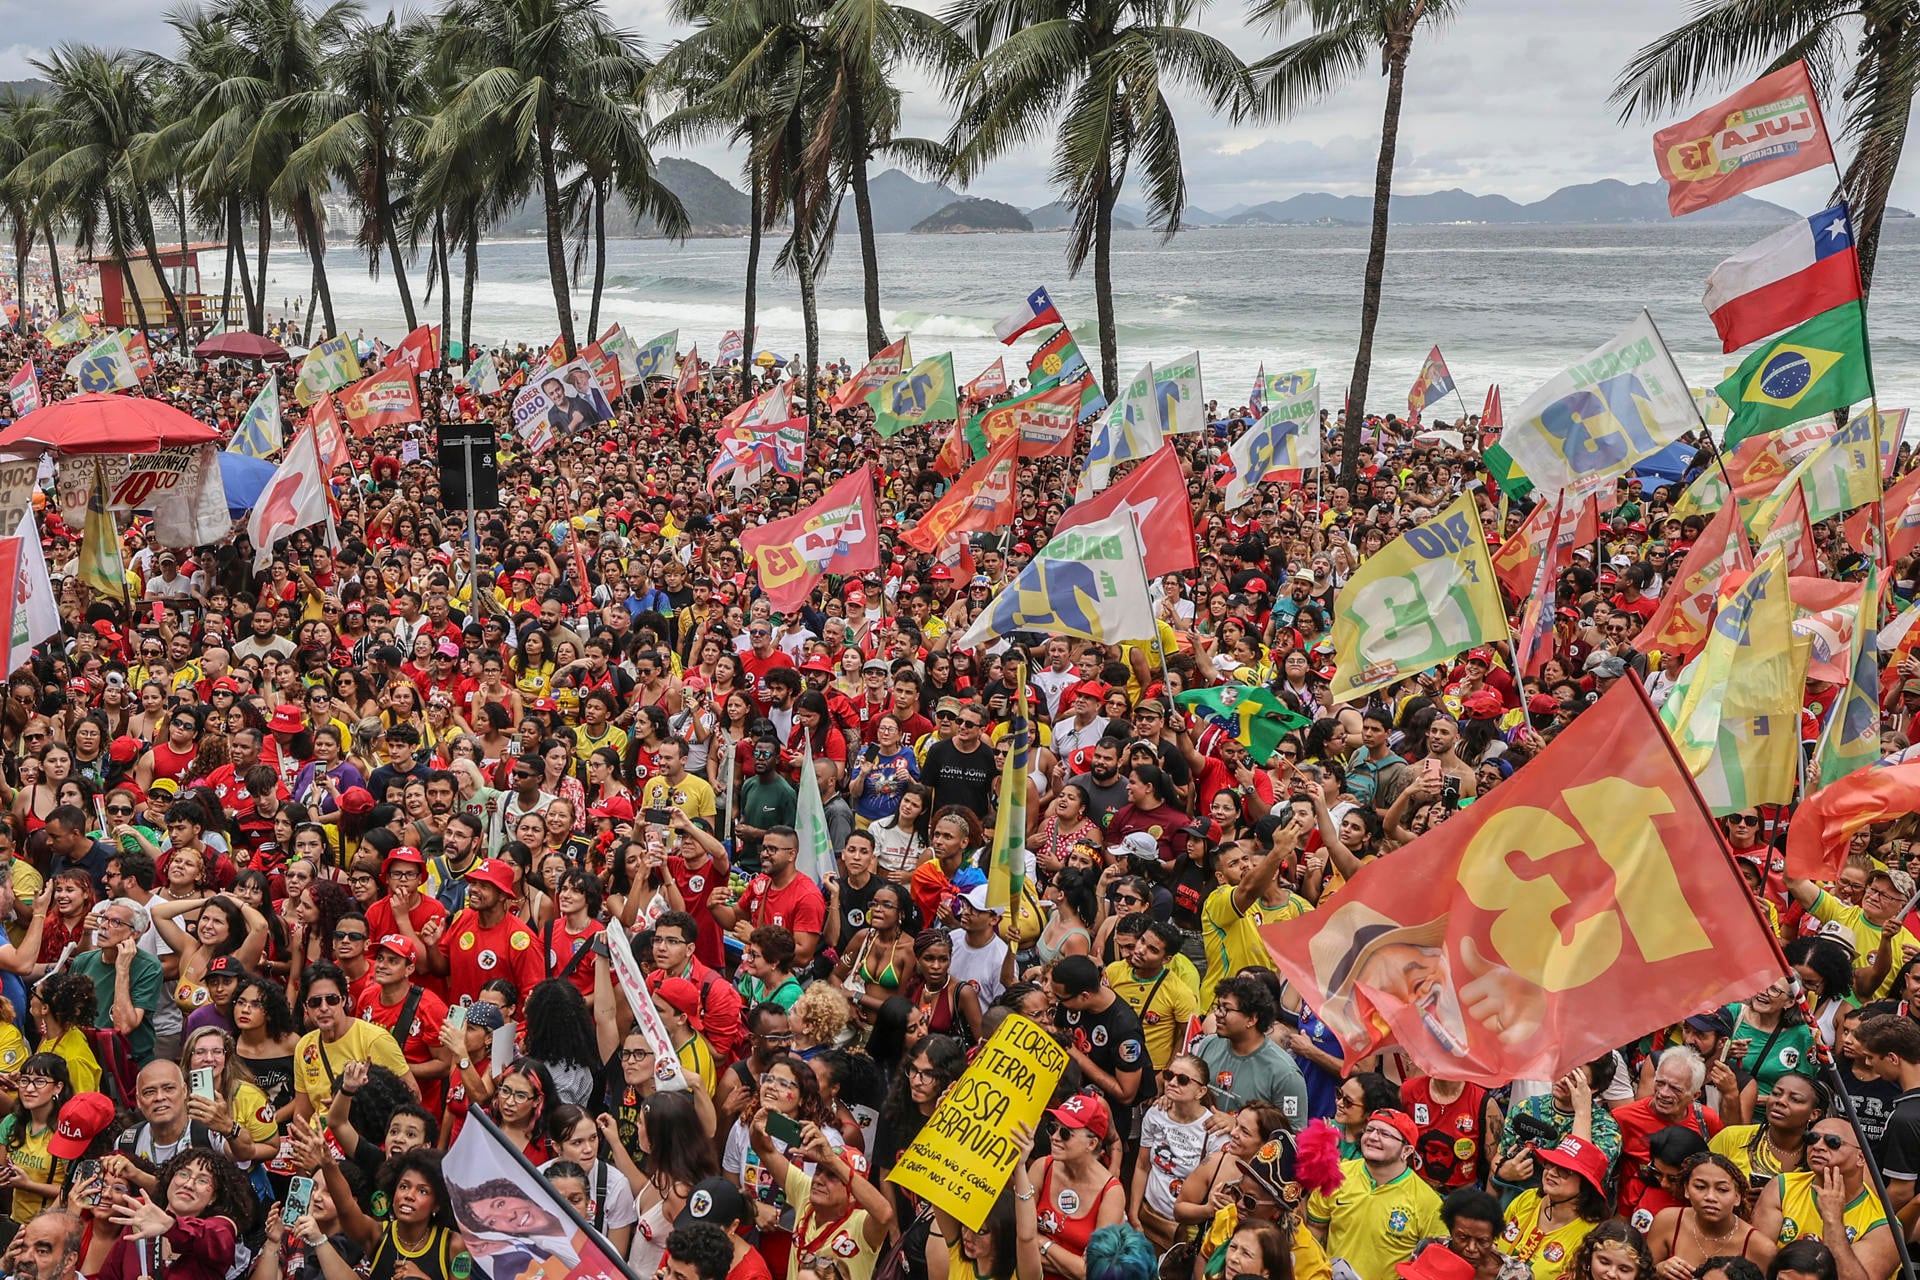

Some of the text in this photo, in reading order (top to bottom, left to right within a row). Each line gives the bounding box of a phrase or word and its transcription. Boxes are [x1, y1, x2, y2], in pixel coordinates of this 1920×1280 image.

[514, 387, 539, 410] AUBER
[129, 454, 190, 473] CAIPIRINHA
[940, 766, 962, 776] JOHN
[964, 768, 987, 779] JOHN
[211, 958, 227, 971] 12
[481, 954, 495, 966] 13
[1784, 1051, 1798, 1064] 13
[951, 1076, 1010, 1127] NOSSA
[57, 1119, 83, 1139] LULA
[10, 1150, 47, 1171] BRASIL
[850, 1154, 867, 1173] 13
[927, 1171, 946, 1186] NOS
[966, 1173, 997, 1199] COLÔNIA
[692, 1196, 710, 1212] 13
[1637, 1215, 1650, 1229] 13
[832, 1234, 856, 1257] 13
